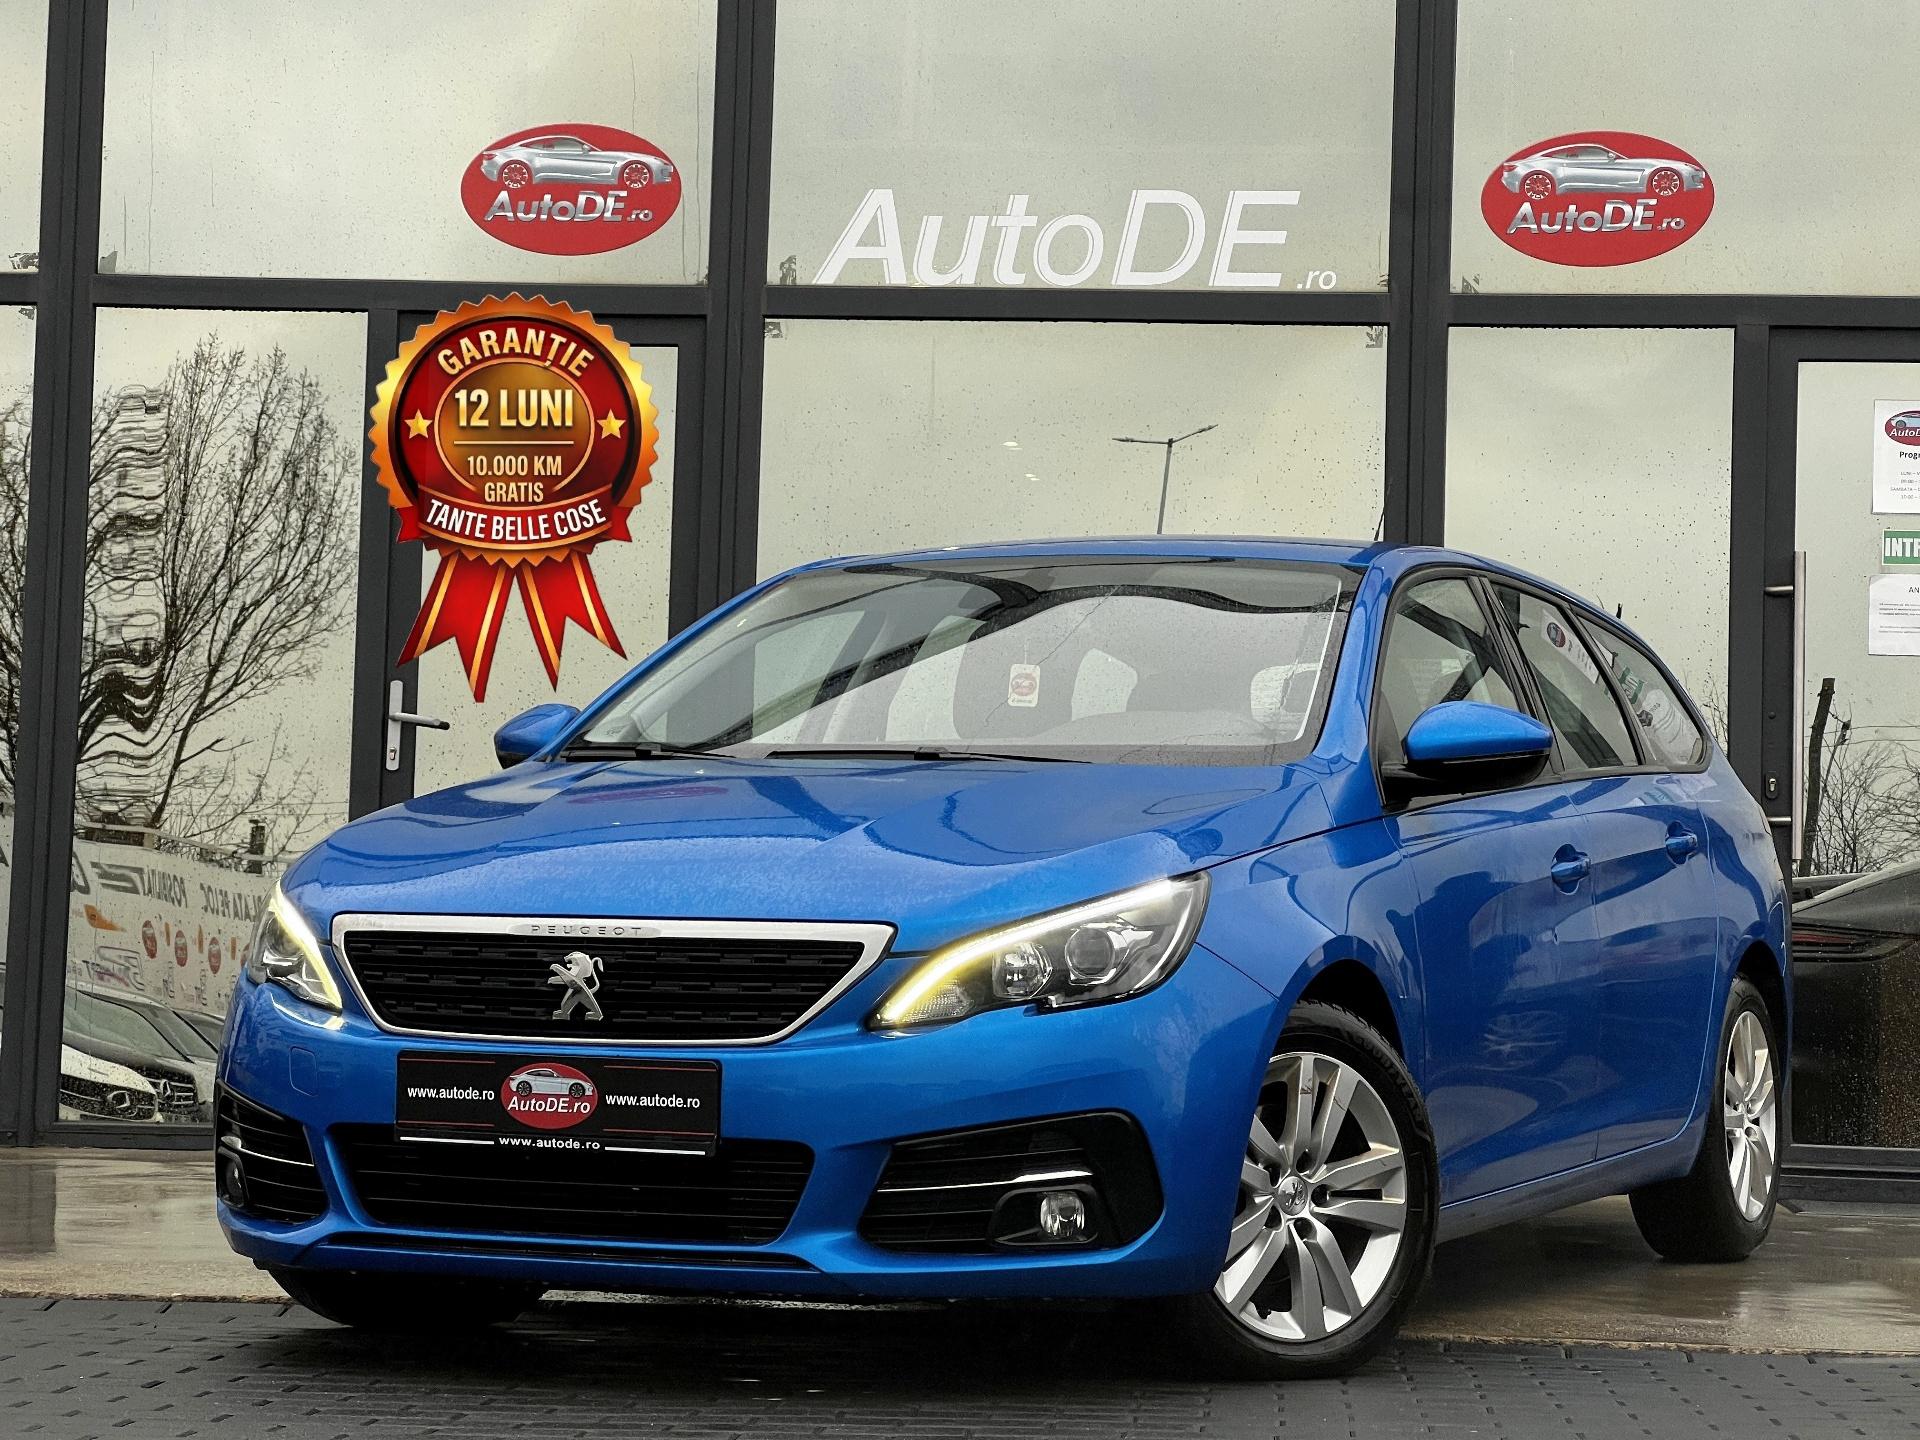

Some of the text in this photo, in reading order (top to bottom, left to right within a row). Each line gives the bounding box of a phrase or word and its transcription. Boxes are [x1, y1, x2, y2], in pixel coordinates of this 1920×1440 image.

[531, 925, 642, 936] PEUGEOT
[407, 1086, 495, 1101] www.autode.ro
[605, 1093, 701, 1109] www.autode.ro
[507, 1096, 591, 1114] AutoDE.ro
[498, 1137, 600, 1150] www.autode.ro
